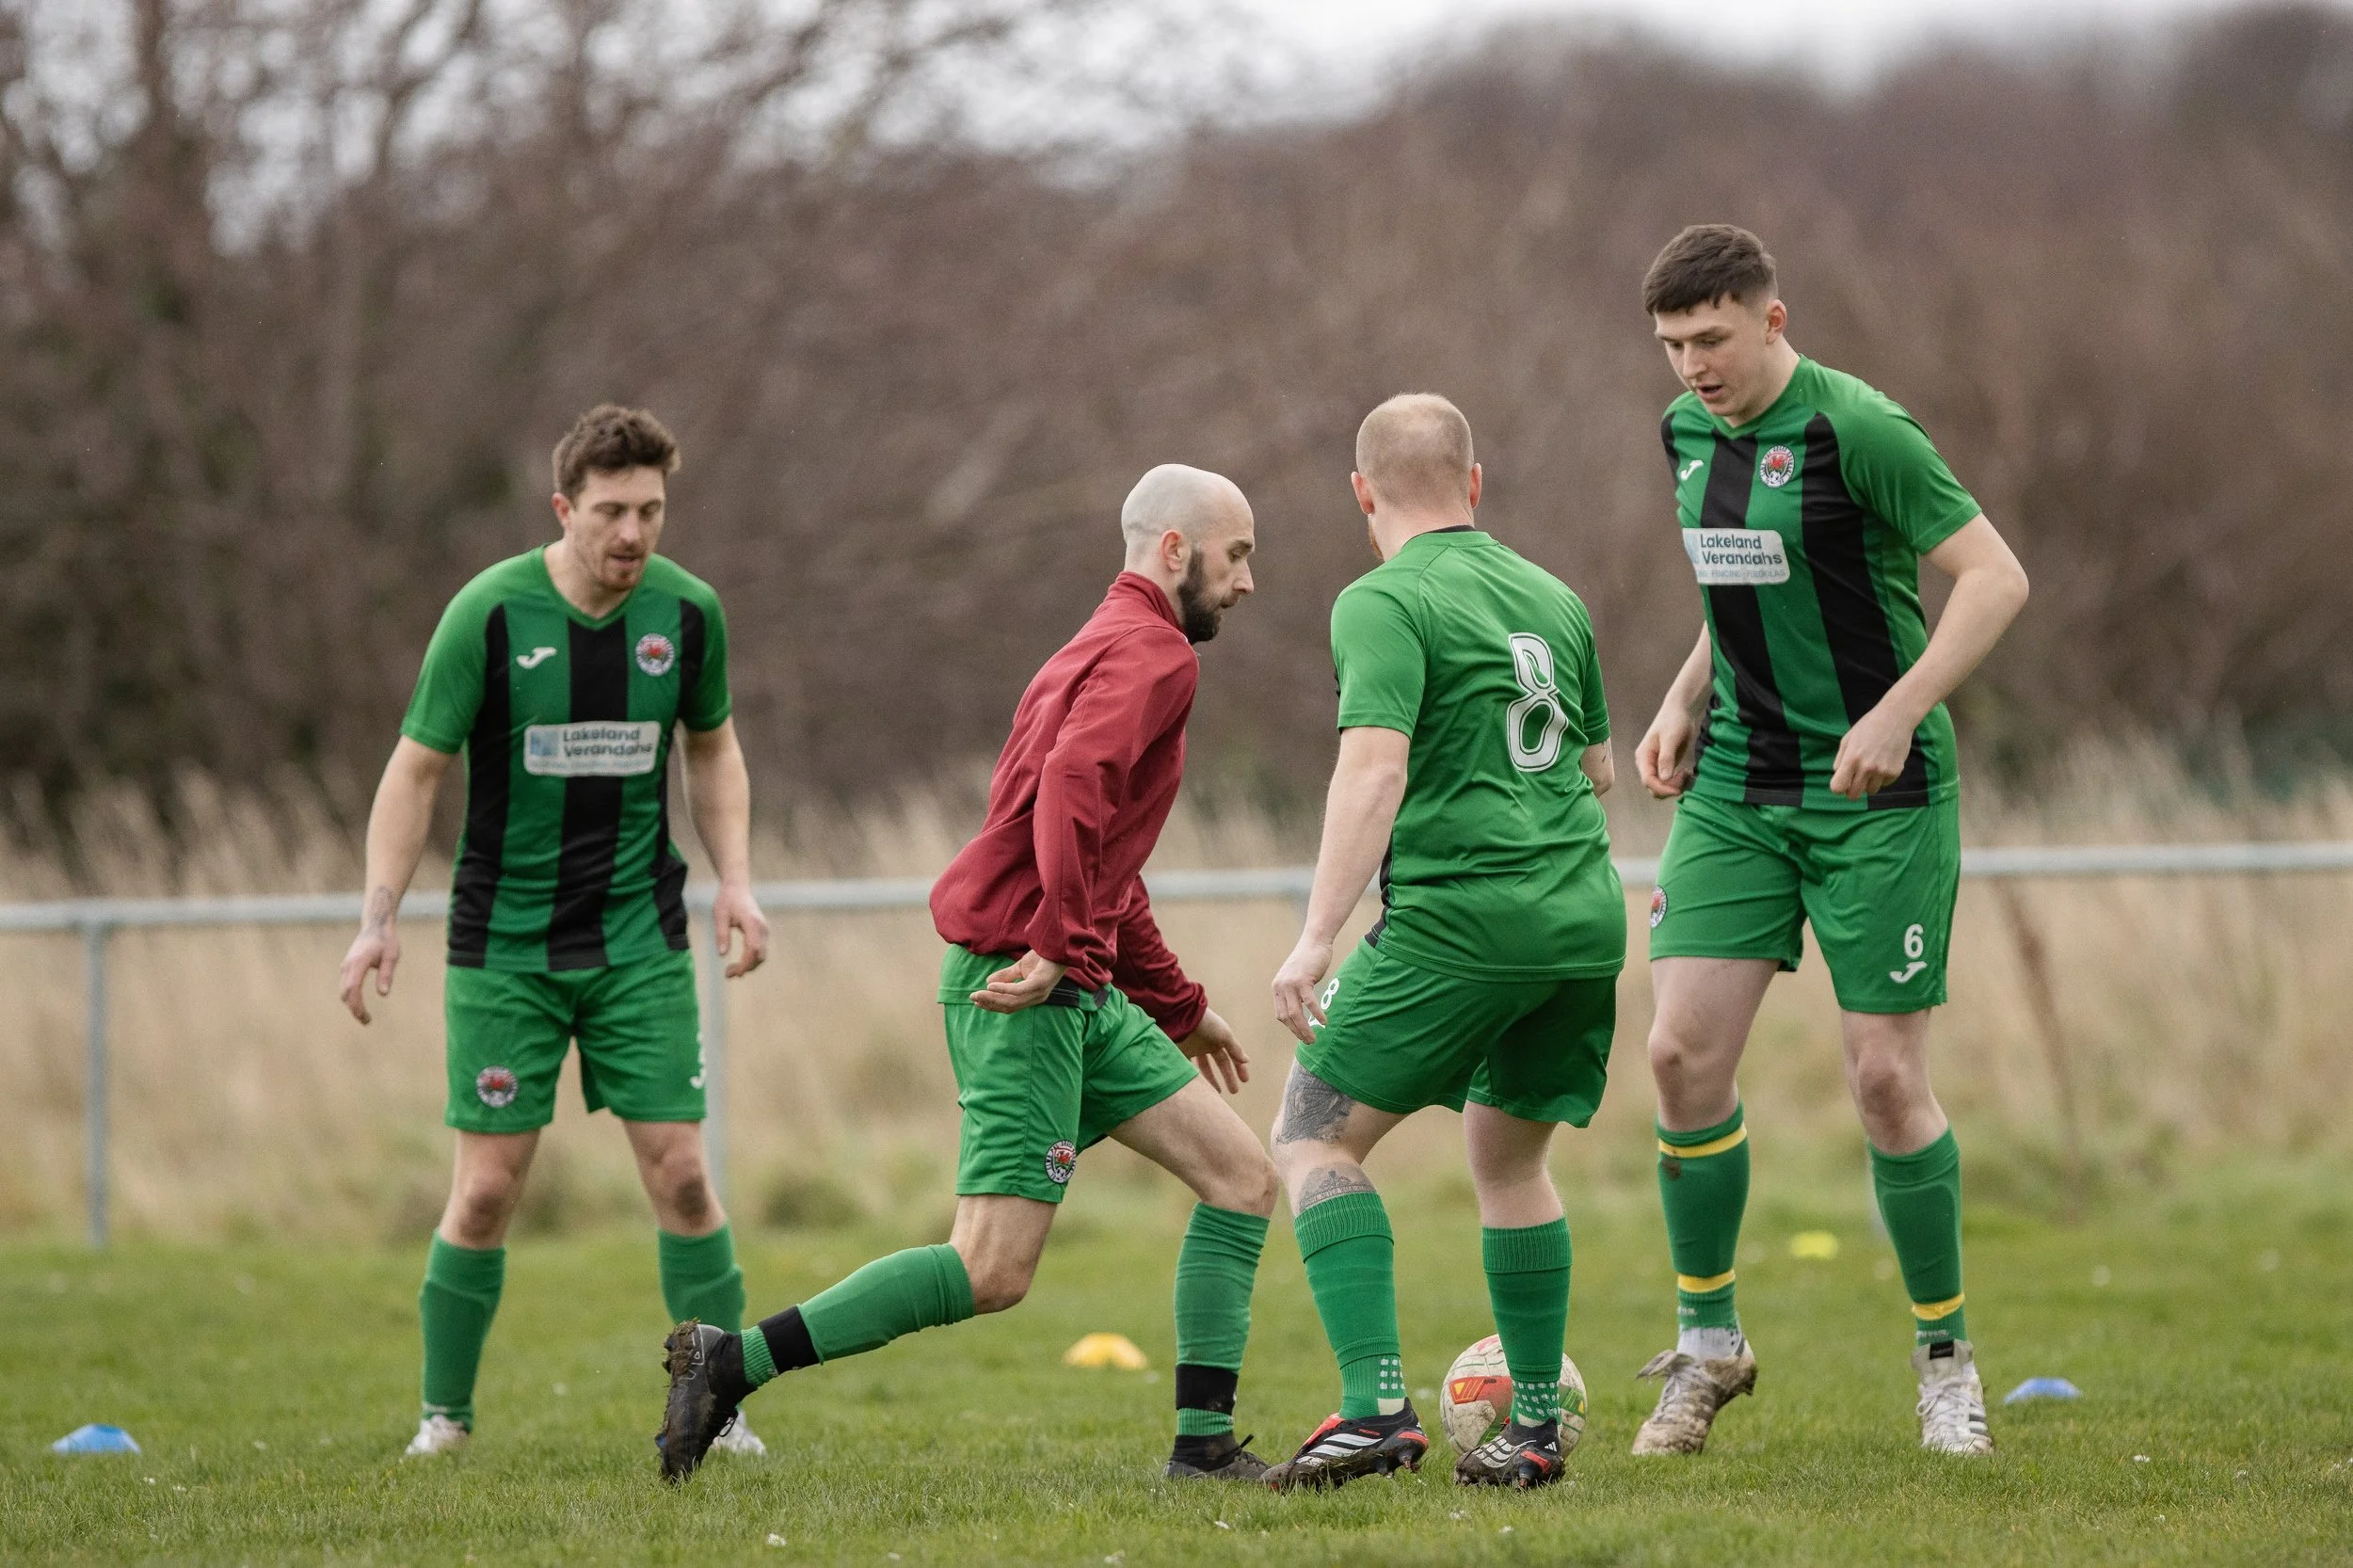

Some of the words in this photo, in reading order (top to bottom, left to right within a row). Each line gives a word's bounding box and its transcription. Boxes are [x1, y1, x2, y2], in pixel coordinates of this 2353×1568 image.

[1700, 533, 1763, 549] Lakeland
[1702, 550, 1784, 565] Verandahs
[1506, 632, 1569, 773] 8
[563, 726, 641, 742] Lakeland
[563, 741, 653, 757] Verandahs
[1903, 923, 1924, 959] 6
[1320, 977, 1340, 1010] 8
